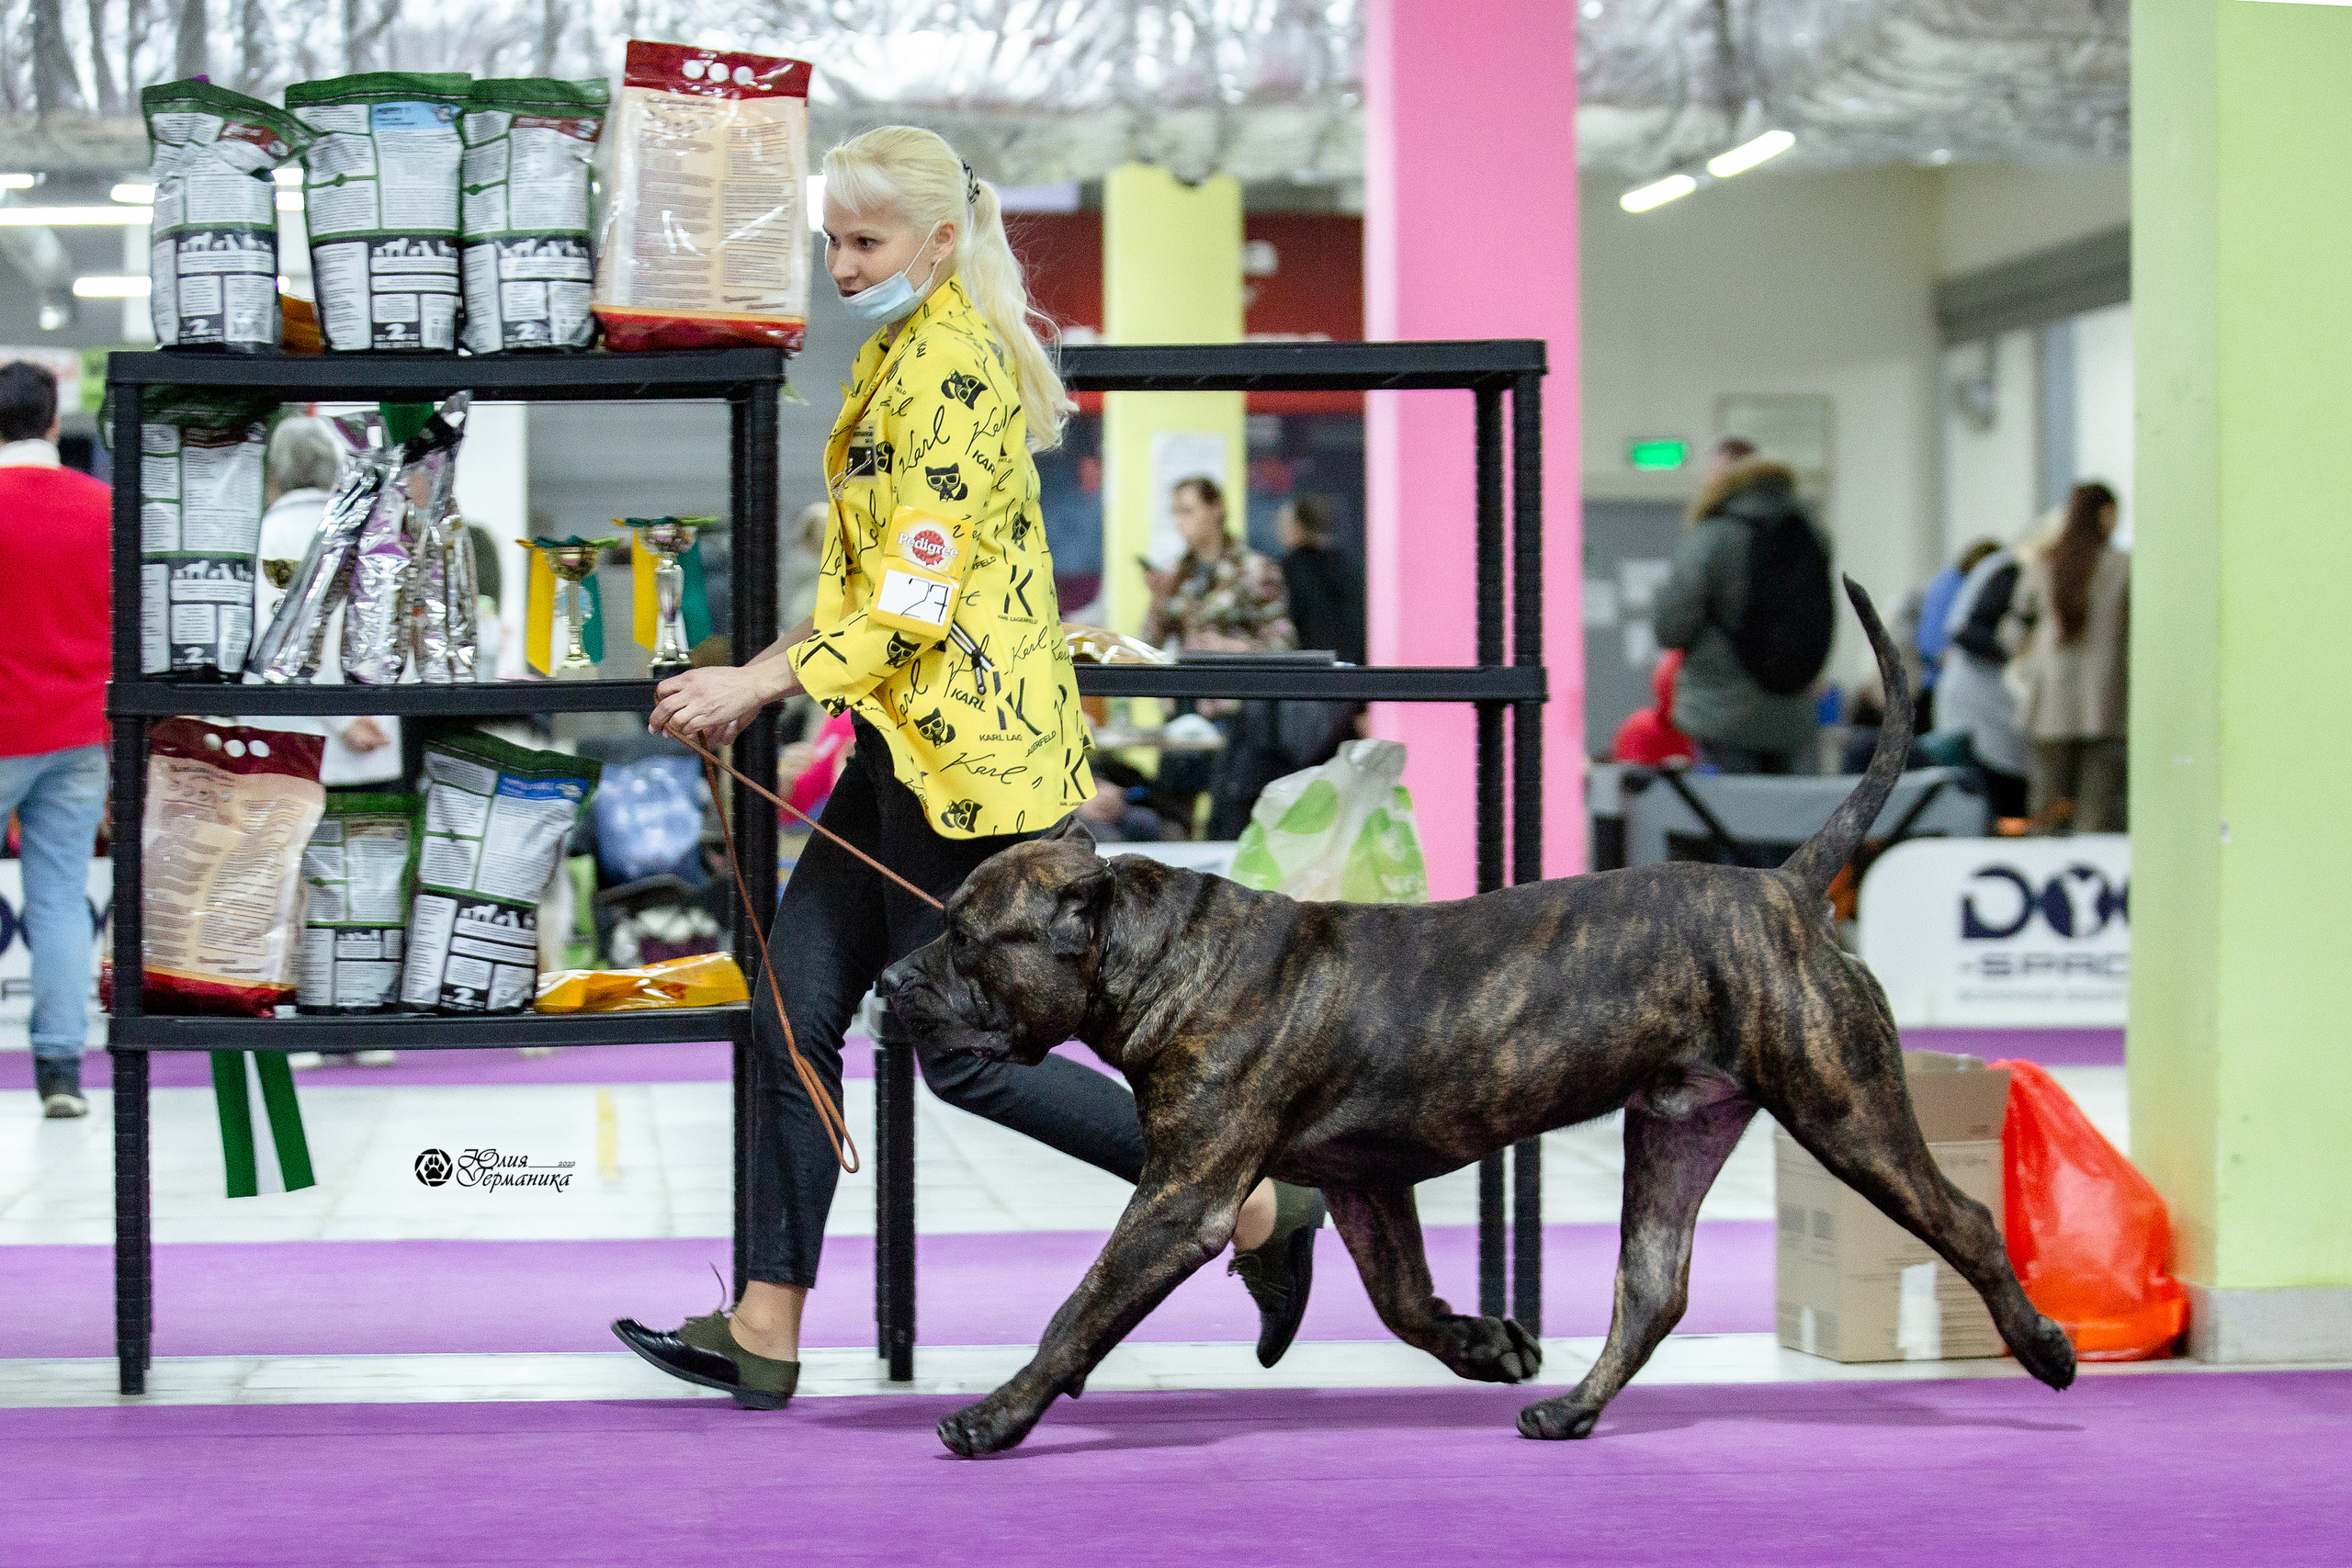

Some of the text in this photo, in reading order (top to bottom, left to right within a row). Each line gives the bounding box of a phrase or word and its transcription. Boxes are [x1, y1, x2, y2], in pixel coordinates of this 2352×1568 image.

[190, 318, 209, 335] 2
[385, 322, 406, 340] 2
[514, 322, 536, 340] 2
[897, 404, 950, 502] Karl
[896, 531, 959, 558] Pedigree
[899, 578, 950, 623] 27
[184, 647, 204, 664] 2
[1008, 626, 1048, 674] Karl
[951, 688, 987, 713] KARL
[940, 752, 1028, 784] Karl
[1962, 865, 2130, 938] DO
[454, 987, 476, 1006] 2
